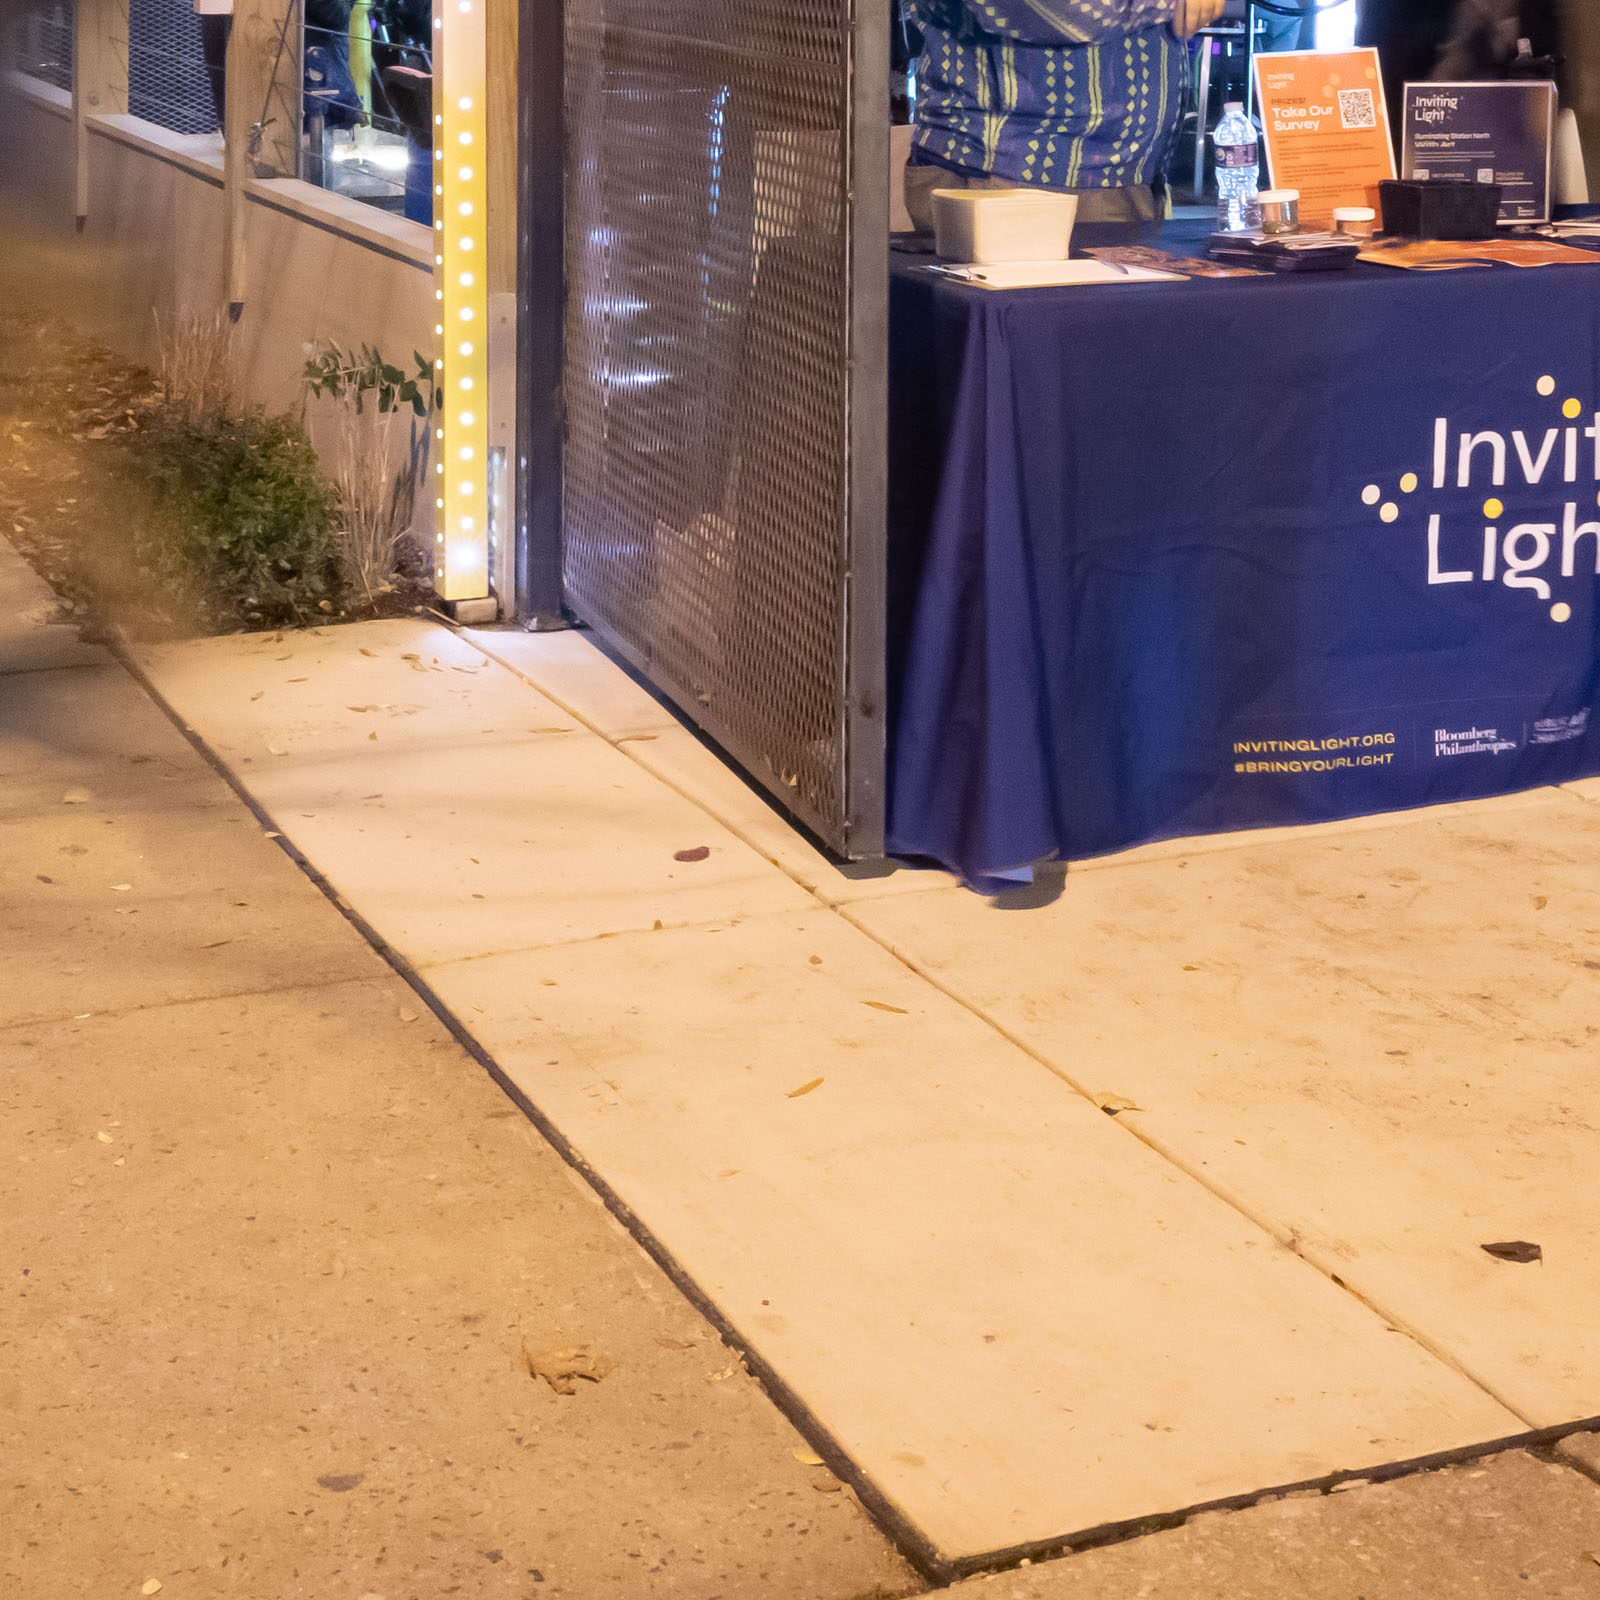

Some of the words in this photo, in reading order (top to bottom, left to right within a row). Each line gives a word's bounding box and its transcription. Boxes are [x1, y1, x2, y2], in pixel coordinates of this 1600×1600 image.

[1415, 94, 1458, 110] Inviting
[1272, 106, 1307, 118] Take
[1309, 105, 1334, 116] Our
[1415, 109, 1445, 123] Light
[1274, 120, 1320, 132] Survey
[1233, 732, 1396, 753] INVITINGLIGHT.ORG
[1434, 726, 1497, 743] Bloomberg
[1434, 738, 1517, 757] Philanthropies
[1234, 753, 1395, 773] #BRINGYOURLIGHT
